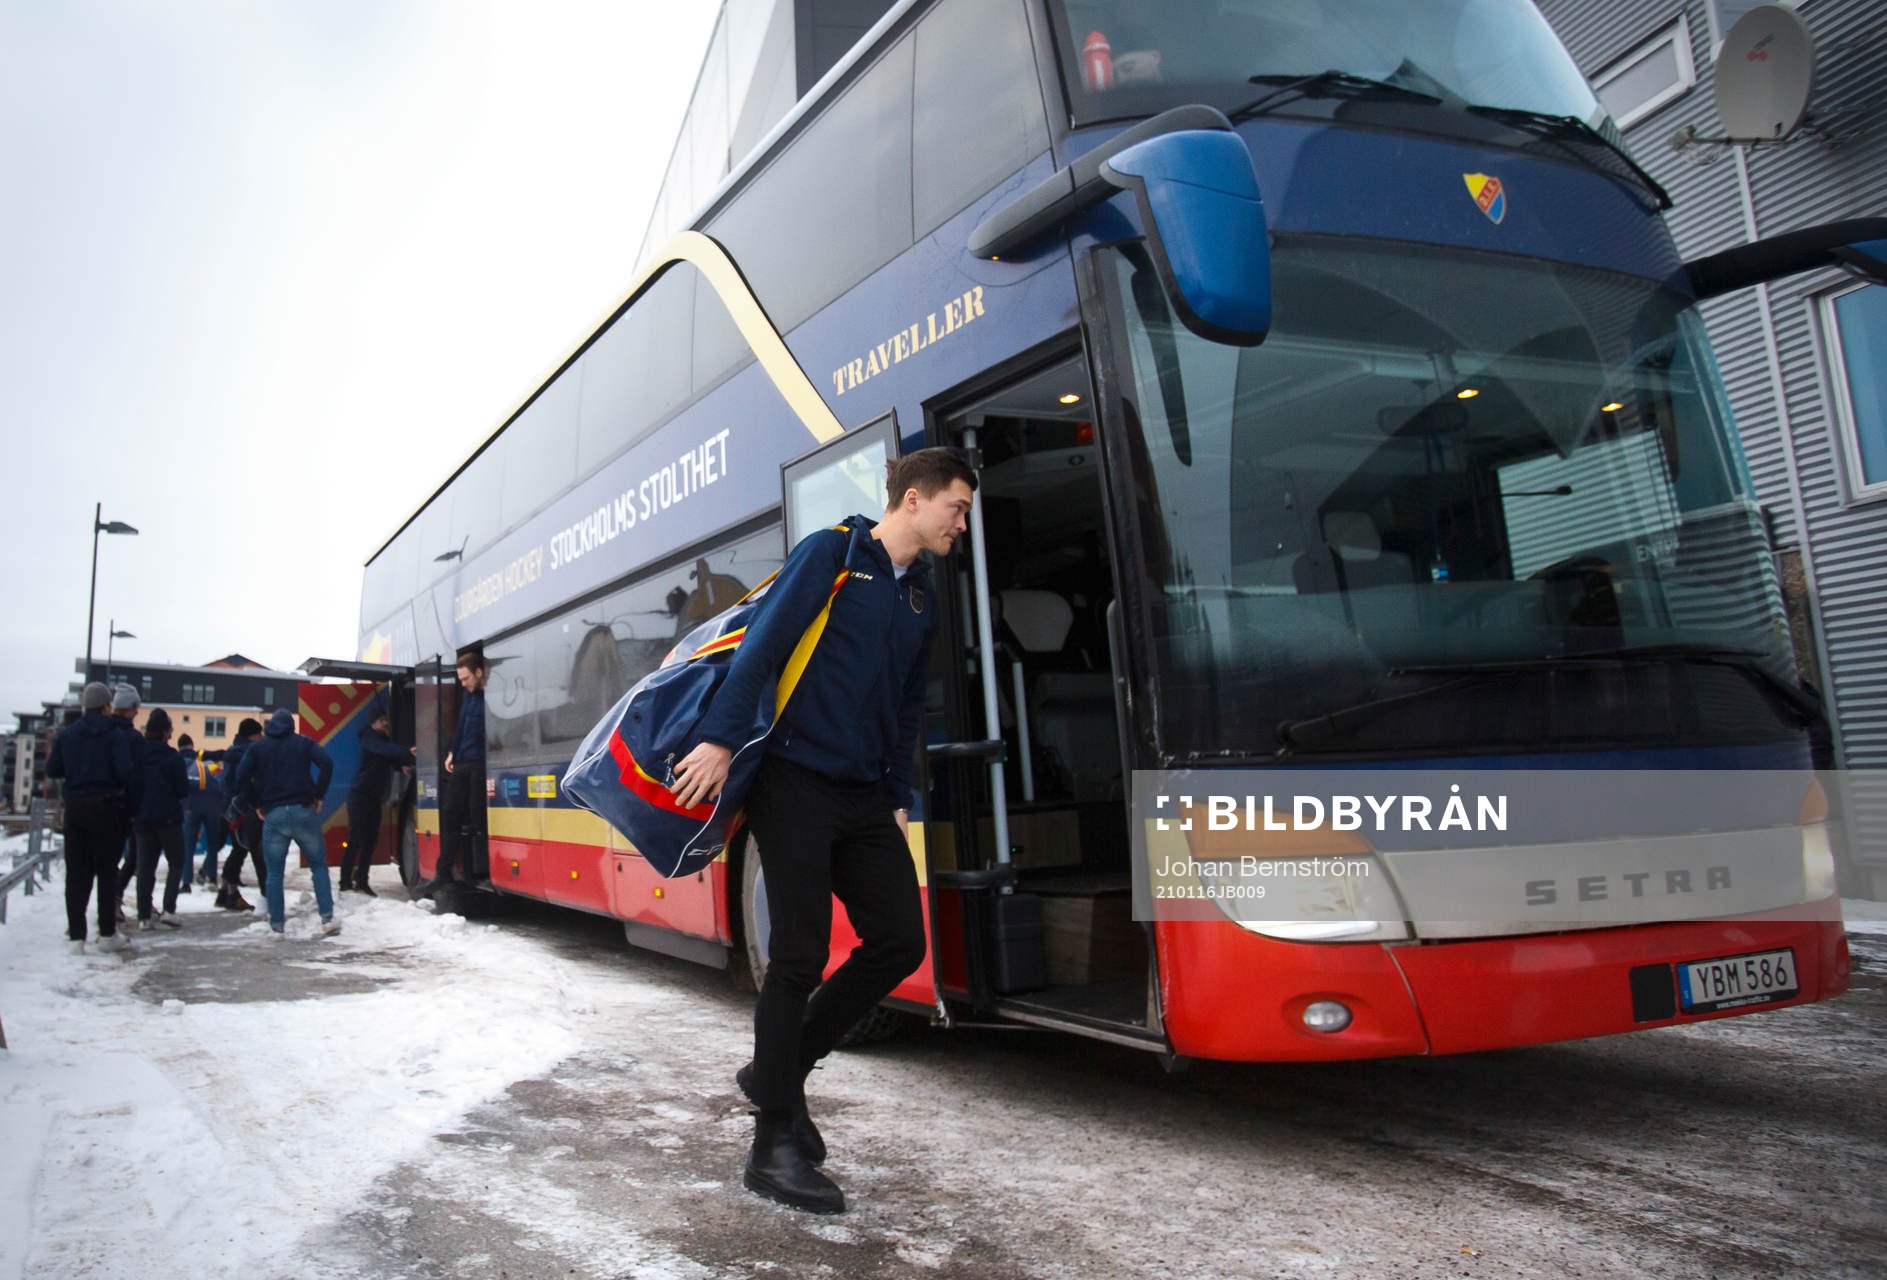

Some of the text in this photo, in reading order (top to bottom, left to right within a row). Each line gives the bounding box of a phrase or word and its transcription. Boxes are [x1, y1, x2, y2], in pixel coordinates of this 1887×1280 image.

[832, 285, 985, 396] TRAVELLER
[550, 488, 636, 570] STOCKHOLMS
[639, 428, 730, 521] STOLTHET
[1525, 866, 1732, 906] SETRA
[1696, 957, 1787, 998] YBM 586
